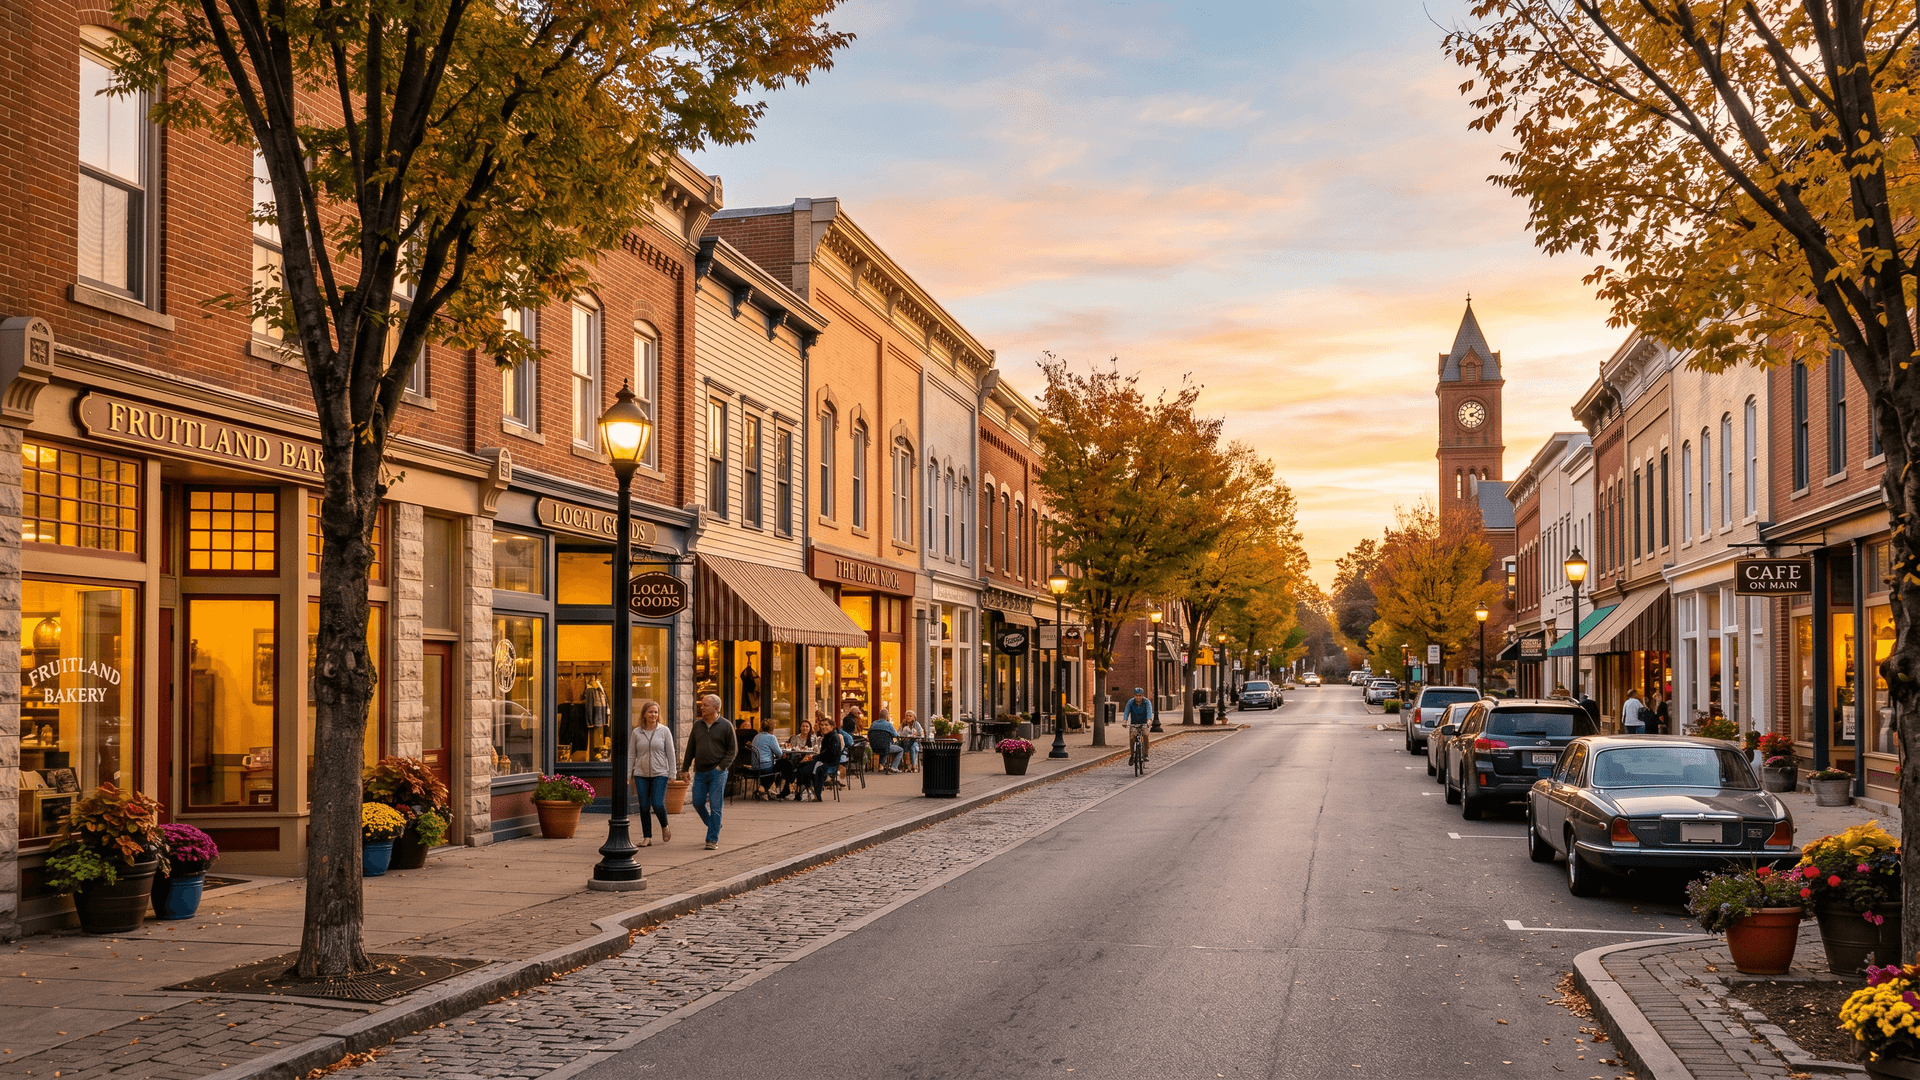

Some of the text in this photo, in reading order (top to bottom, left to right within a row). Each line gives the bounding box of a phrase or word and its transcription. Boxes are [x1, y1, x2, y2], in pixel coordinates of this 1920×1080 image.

[110, 402, 325, 474] FRUITLAND BAK
[554, 504, 645, 541] LOCAL GODS
[836, 559, 854, 580] THE
[1745, 565, 1801, 580] CAFE
[632, 584, 678, 595] LOCAL
[1749, 581, 1798, 589] ON MAIN
[631, 597, 680, 607] GOODS
[28, 657, 120, 689] FRUITLAND
[43, 688, 107, 703] BAKERY
